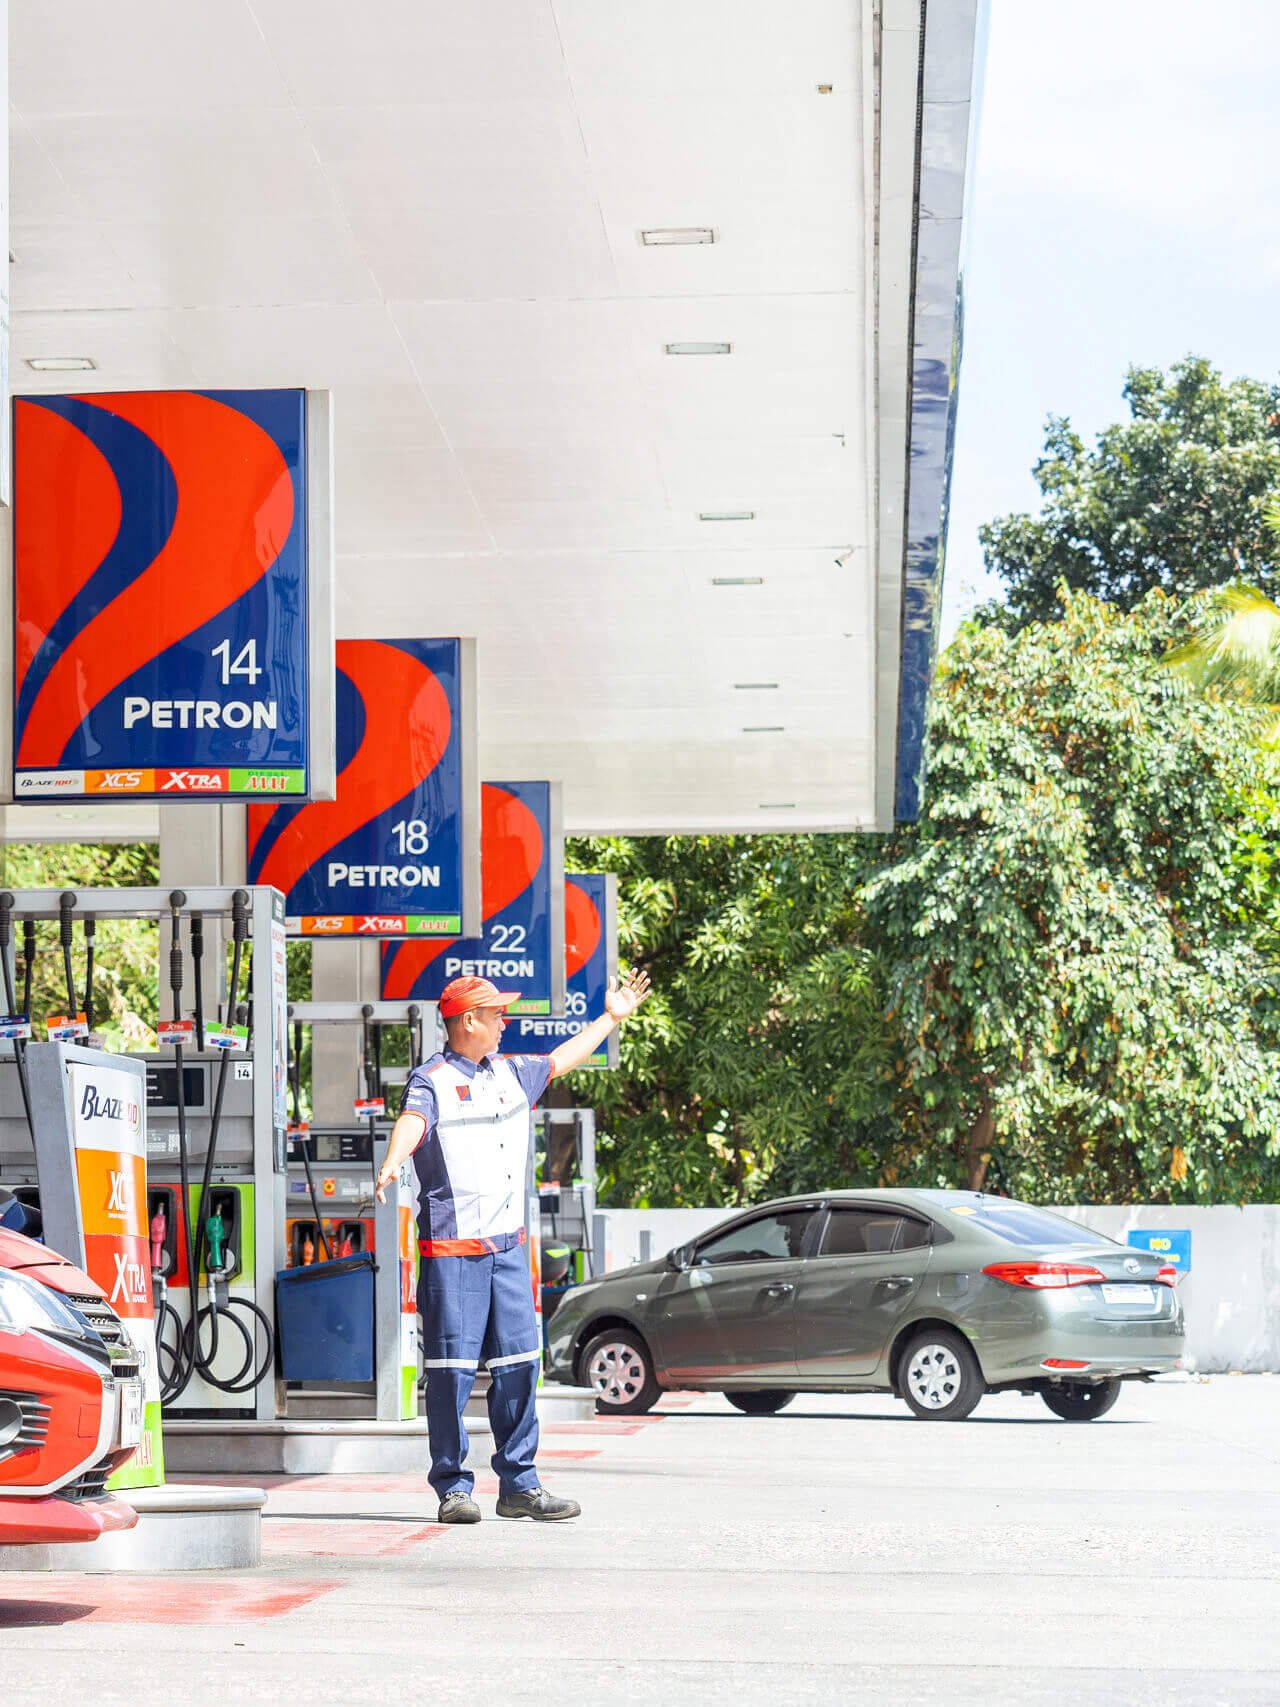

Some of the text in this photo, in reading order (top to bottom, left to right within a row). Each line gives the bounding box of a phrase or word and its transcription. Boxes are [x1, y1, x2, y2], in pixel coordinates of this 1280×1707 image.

[211, 639, 262, 685] 14
[124, 697, 277, 729] PETRON
[100, 771, 143, 787] XCS
[161, 771, 221, 789] XTRA
[391, 820, 429, 855] 18
[328, 862, 441, 887] PETRON
[312, 917, 345, 929] XCS
[358, 916, 403, 931] XTRA
[489, 924, 527, 953] 22
[445, 957, 534, 977] PETRON
[237, 1068, 250, 1078] 14
[110, 1252, 147, 1303] XTRA
